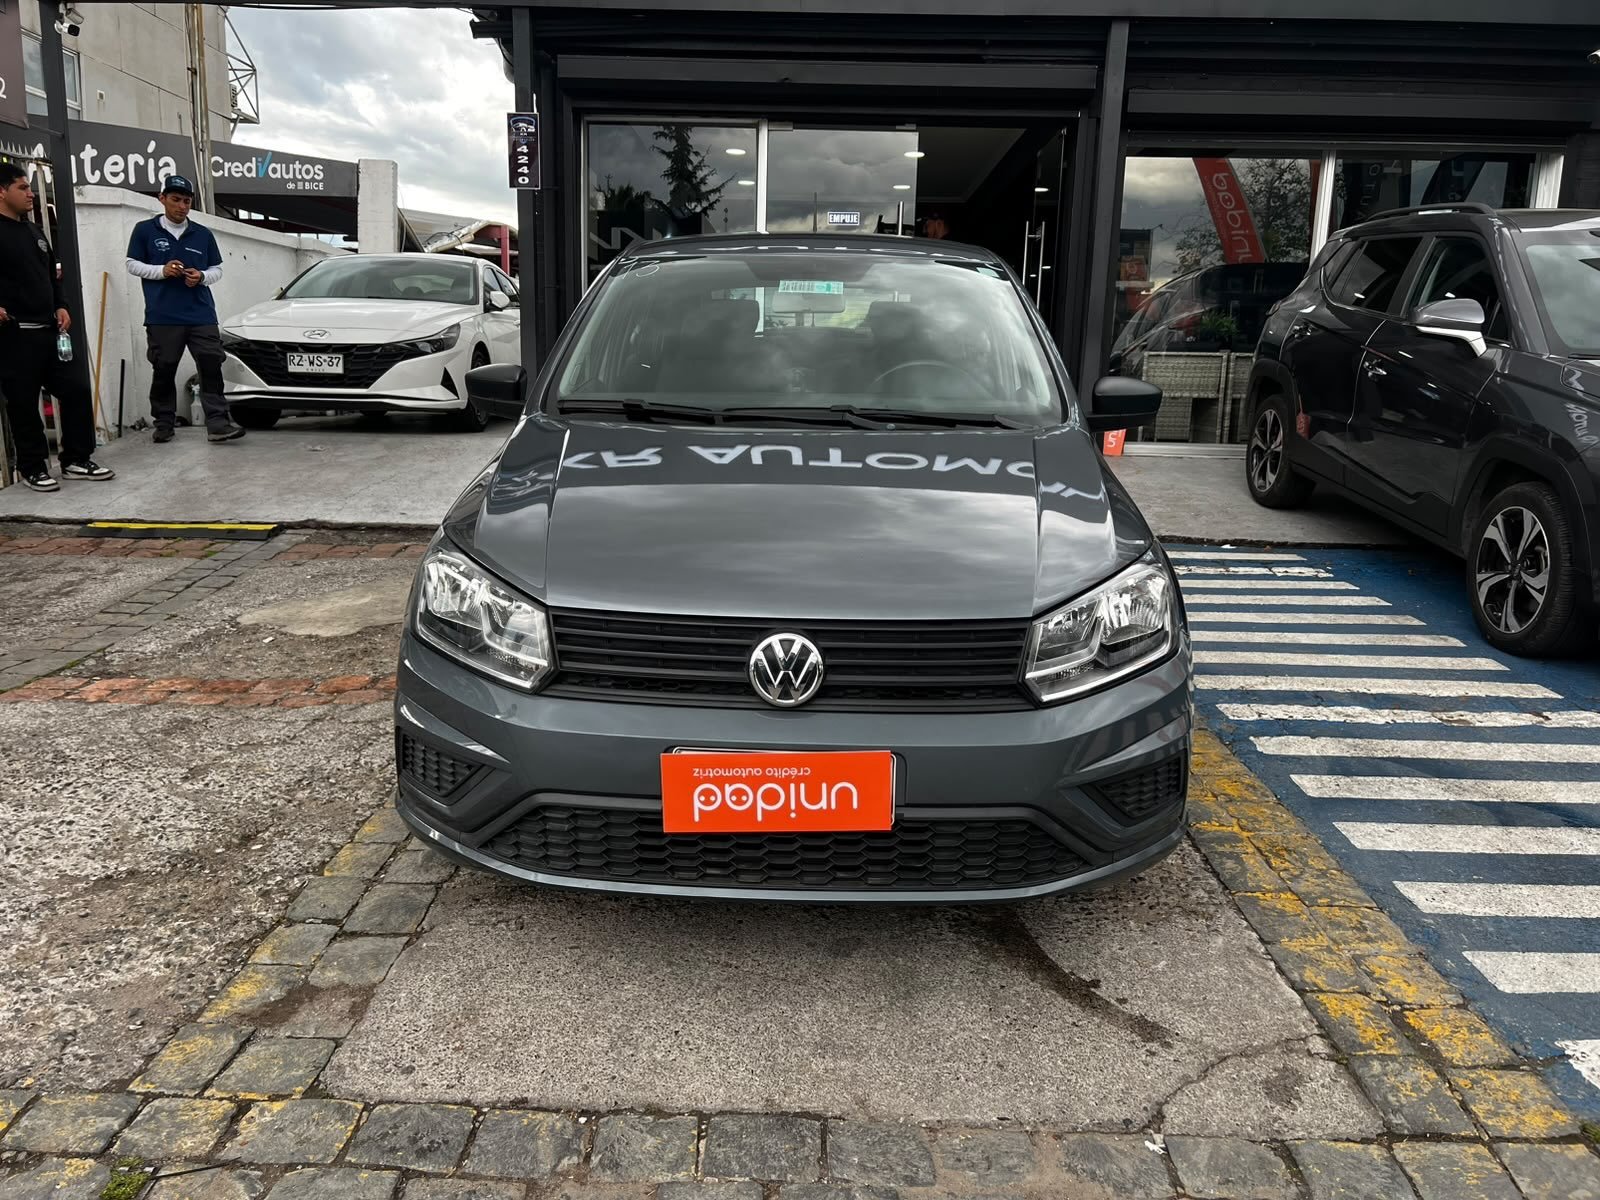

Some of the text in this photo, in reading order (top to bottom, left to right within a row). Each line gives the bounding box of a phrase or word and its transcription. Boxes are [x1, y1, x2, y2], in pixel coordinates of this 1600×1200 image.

[516, 145, 530, 184] 4240
[286, 181, 325, 190] de BICE
[829, 214, 858, 223] EMPUJE
[692, 766, 811, 780] crédito automotriz
[692, 781, 859, 823] unidad
